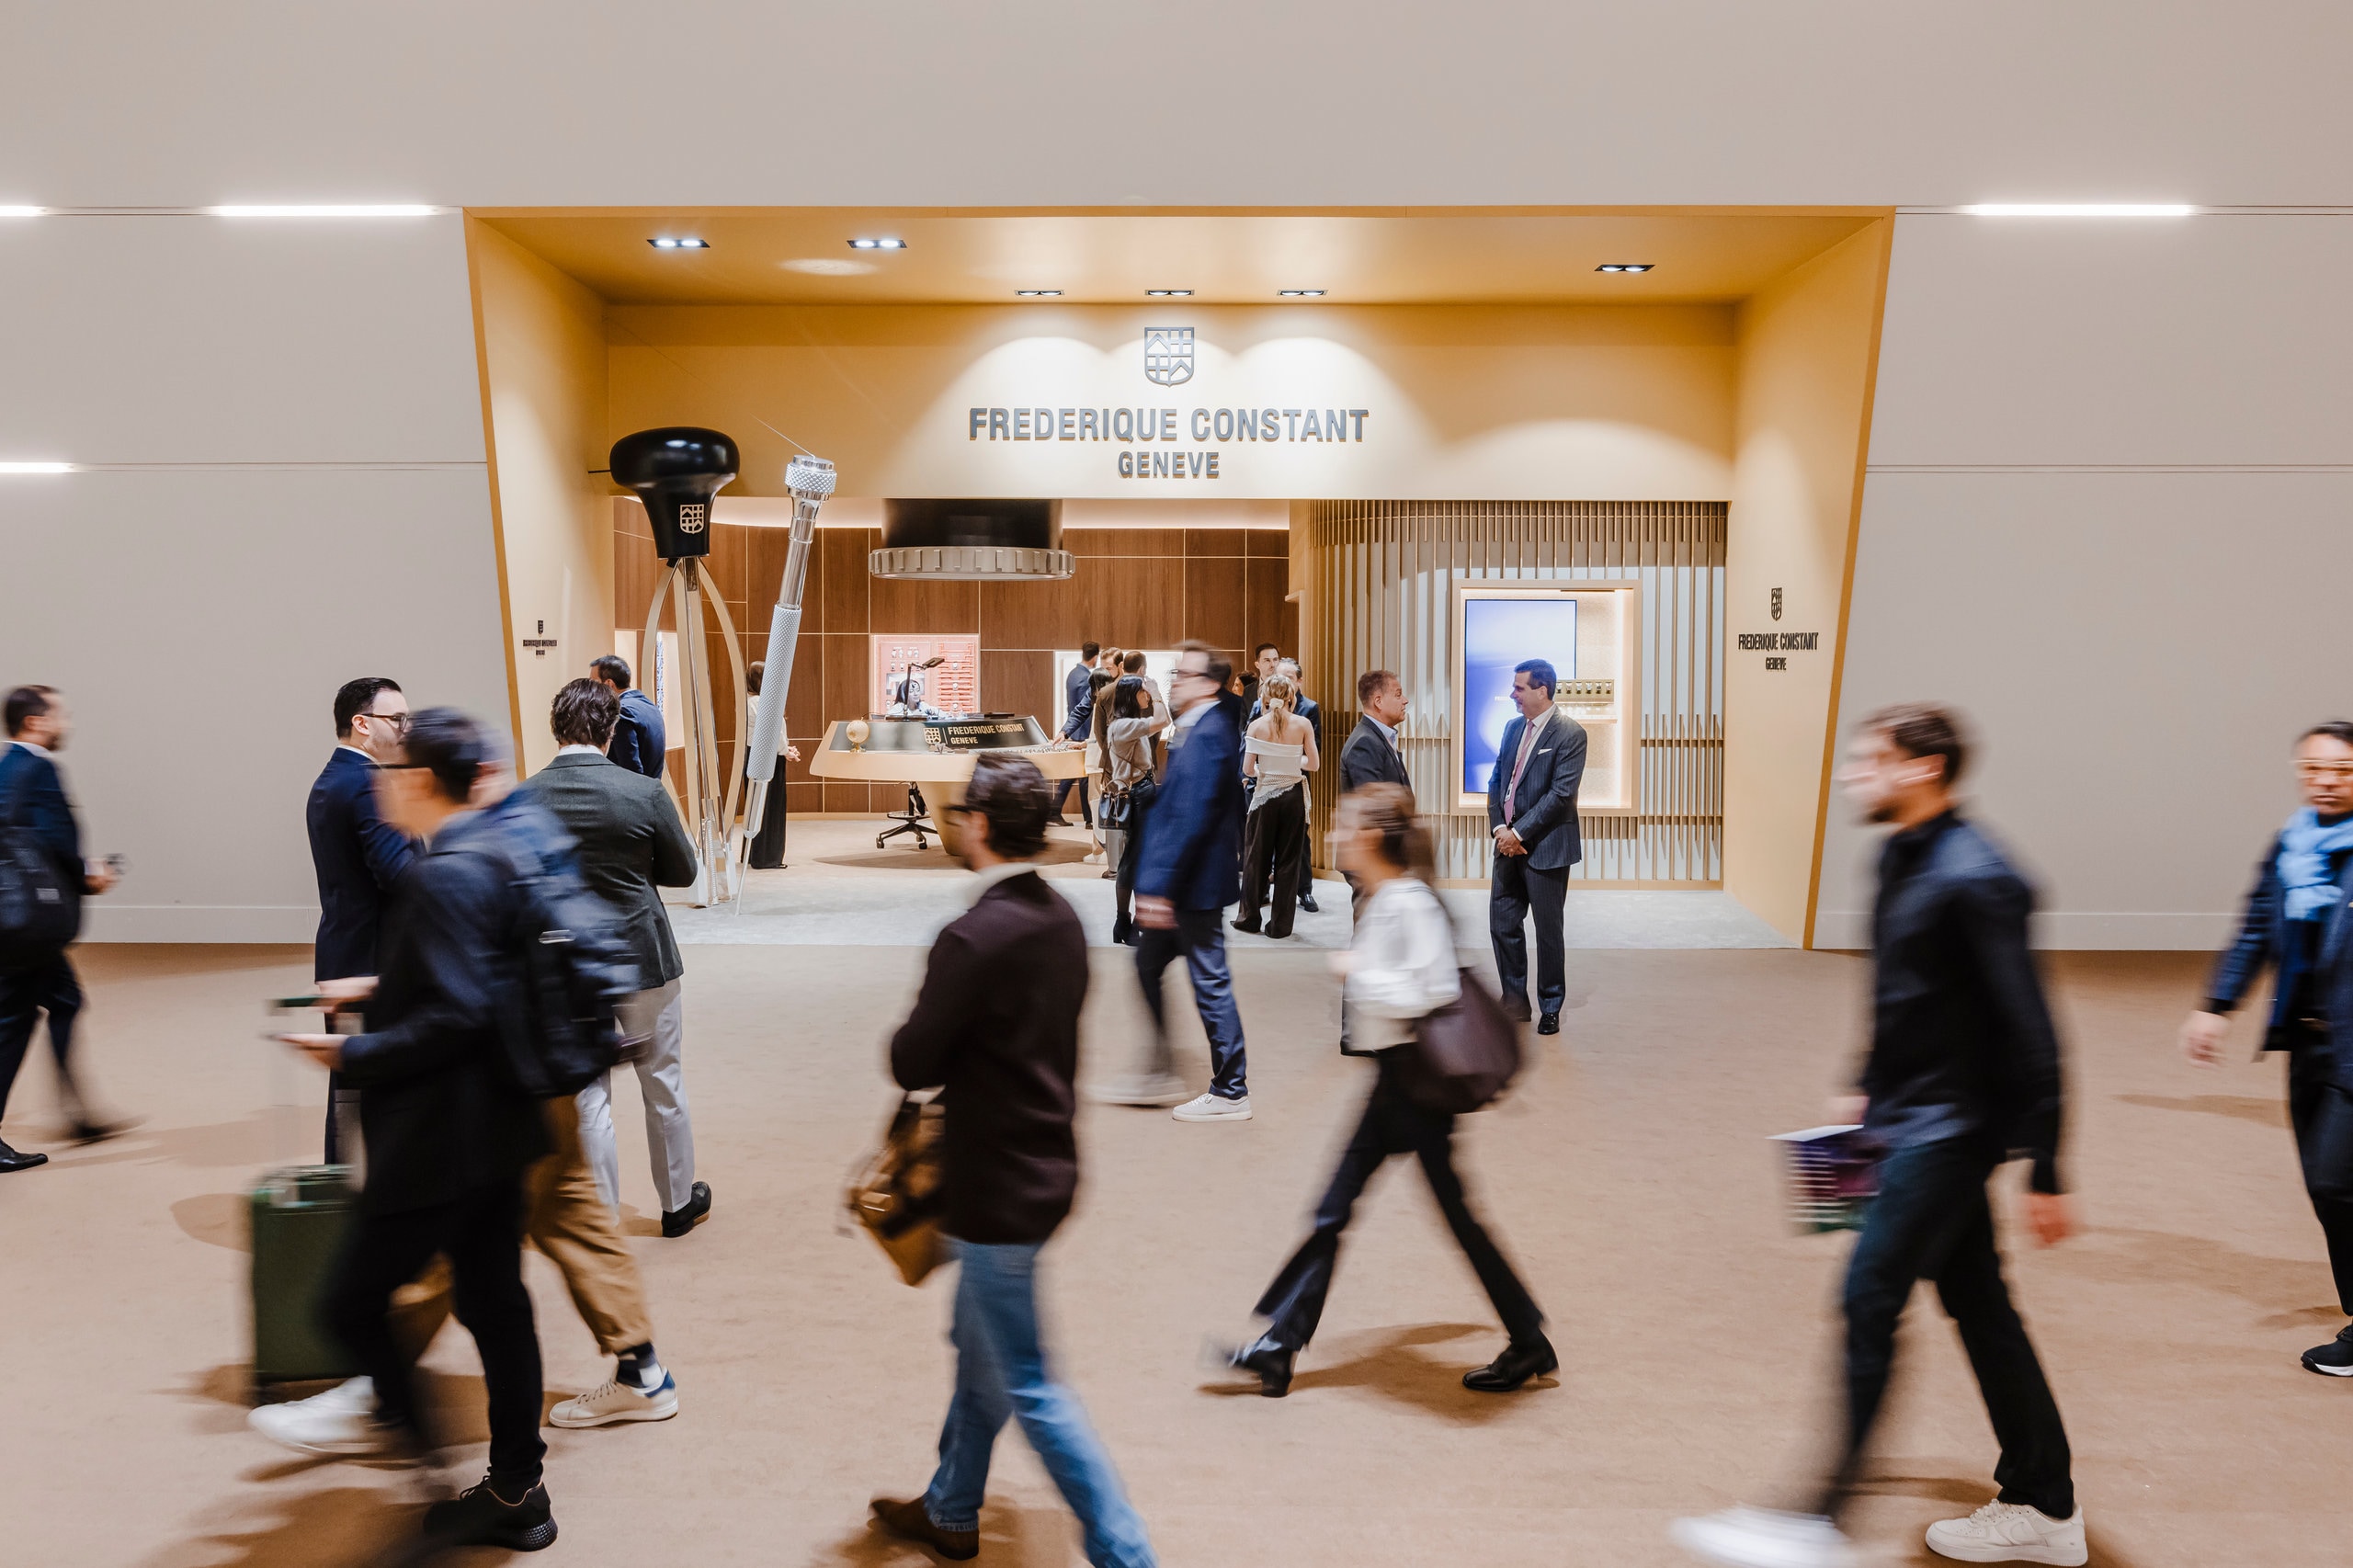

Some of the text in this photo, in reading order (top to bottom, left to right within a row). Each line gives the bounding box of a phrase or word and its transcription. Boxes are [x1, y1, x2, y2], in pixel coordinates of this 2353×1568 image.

[969, 407, 1370, 443] FREDERIQUE CONSTANT
[1118, 450, 1220, 478] GENEVE
[1738, 632, 1819, 652] FREDERIQUE CONSTANT
[1765, 657, 1787, 671] GENEVE
[948, 723, 1025, 735] FREDERIQUE CONSTANT
[950, 736, 978, 744] GENEVE
